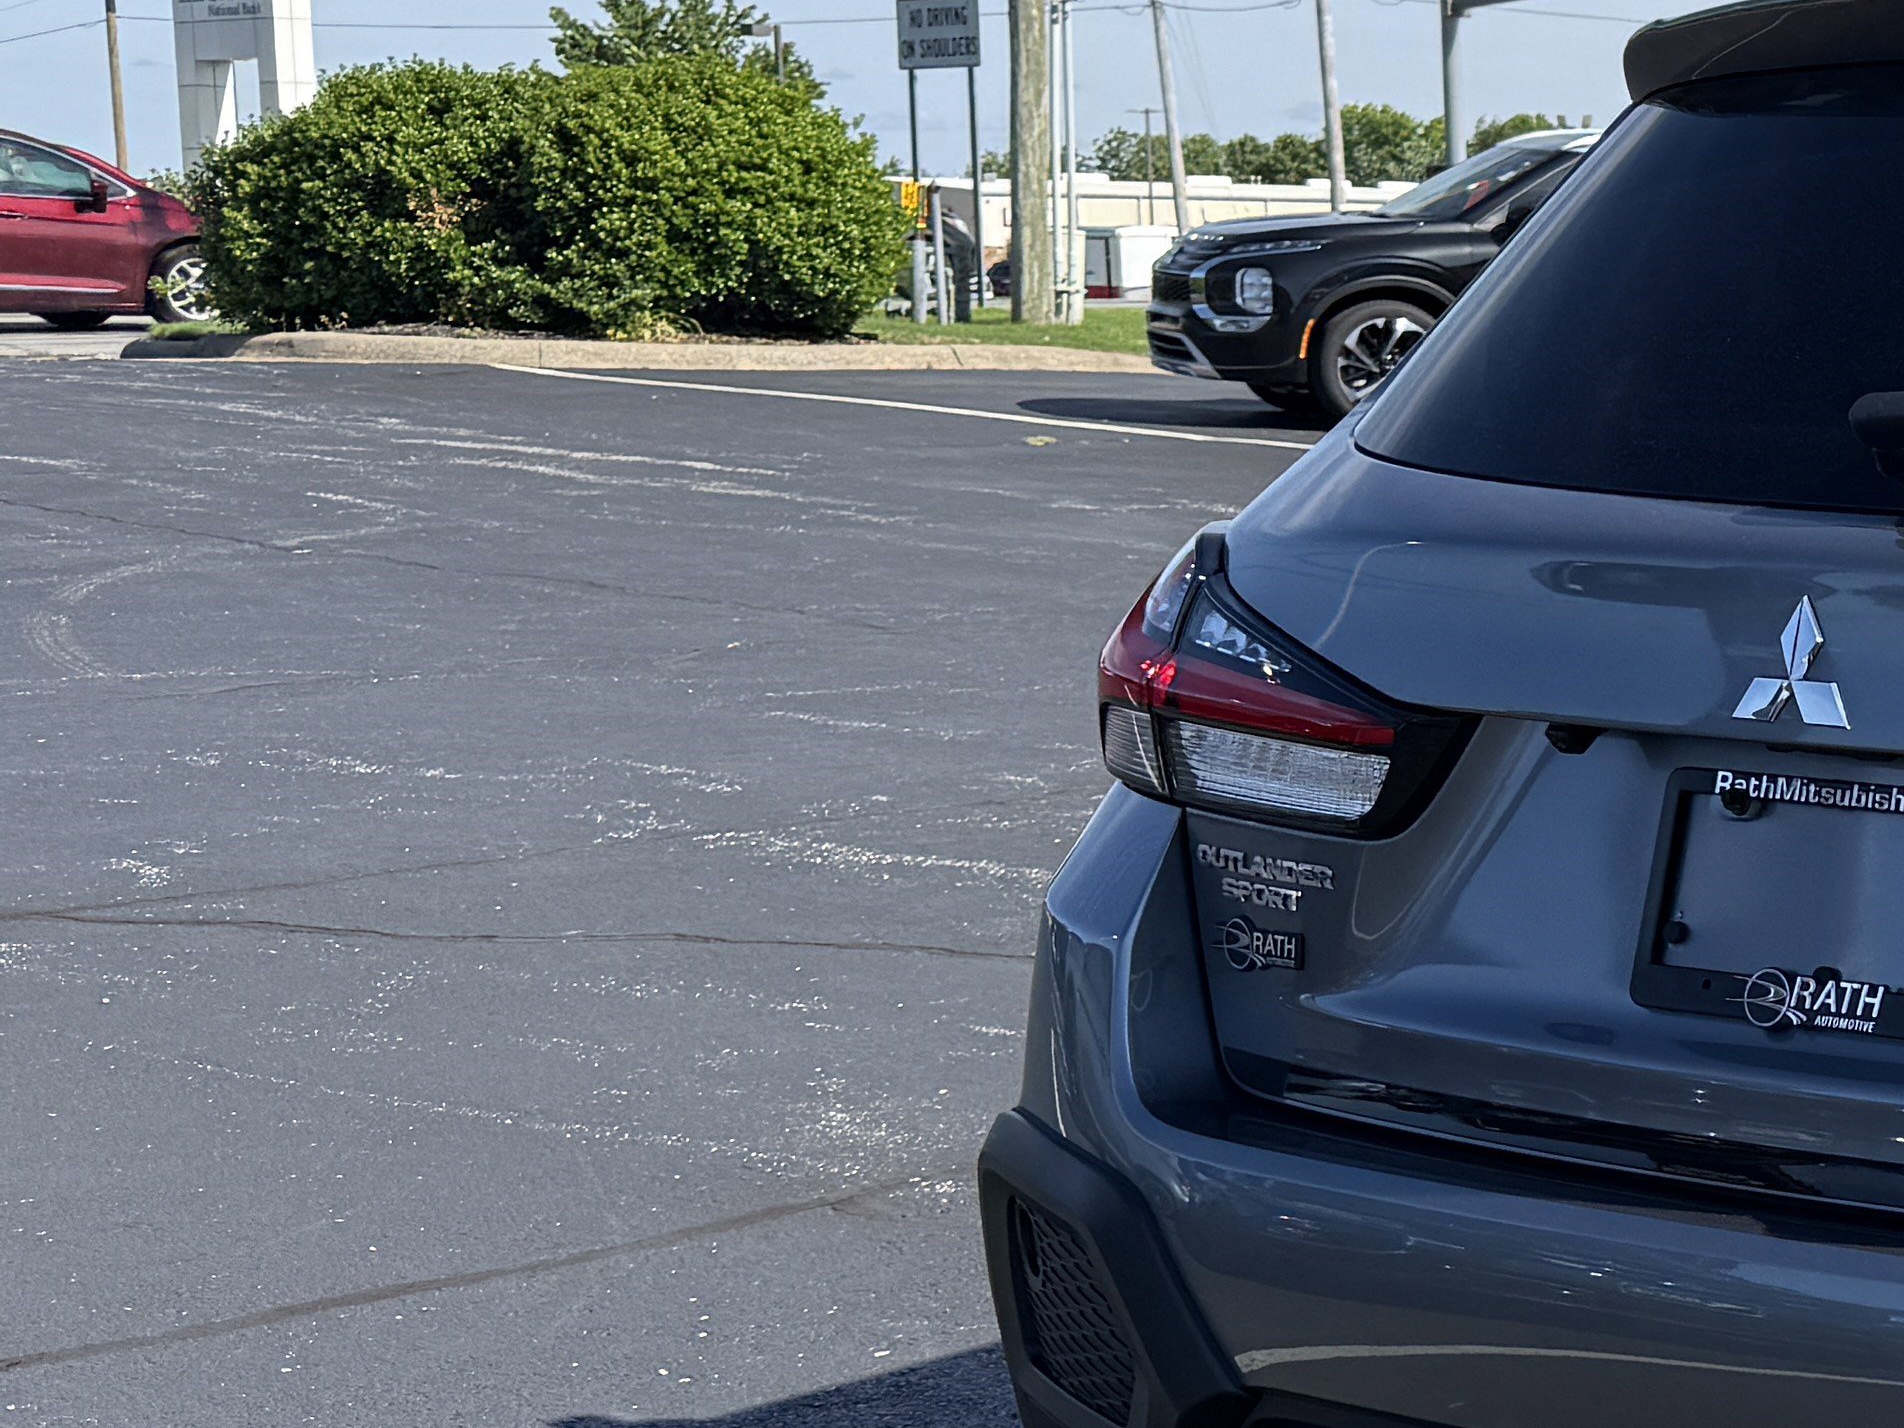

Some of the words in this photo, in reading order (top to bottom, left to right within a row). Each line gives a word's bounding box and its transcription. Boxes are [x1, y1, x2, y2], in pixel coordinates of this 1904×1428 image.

[1197, 843, 1335, 891] OUTLANDER
[1222, 877, 1302, 912] SPORT
[1253, 932, 1296, 959] RATH
[1790, 976, 1885, 1018] RATH
[1814, 1015, 1876, 1033] AUTOMOTIVE
